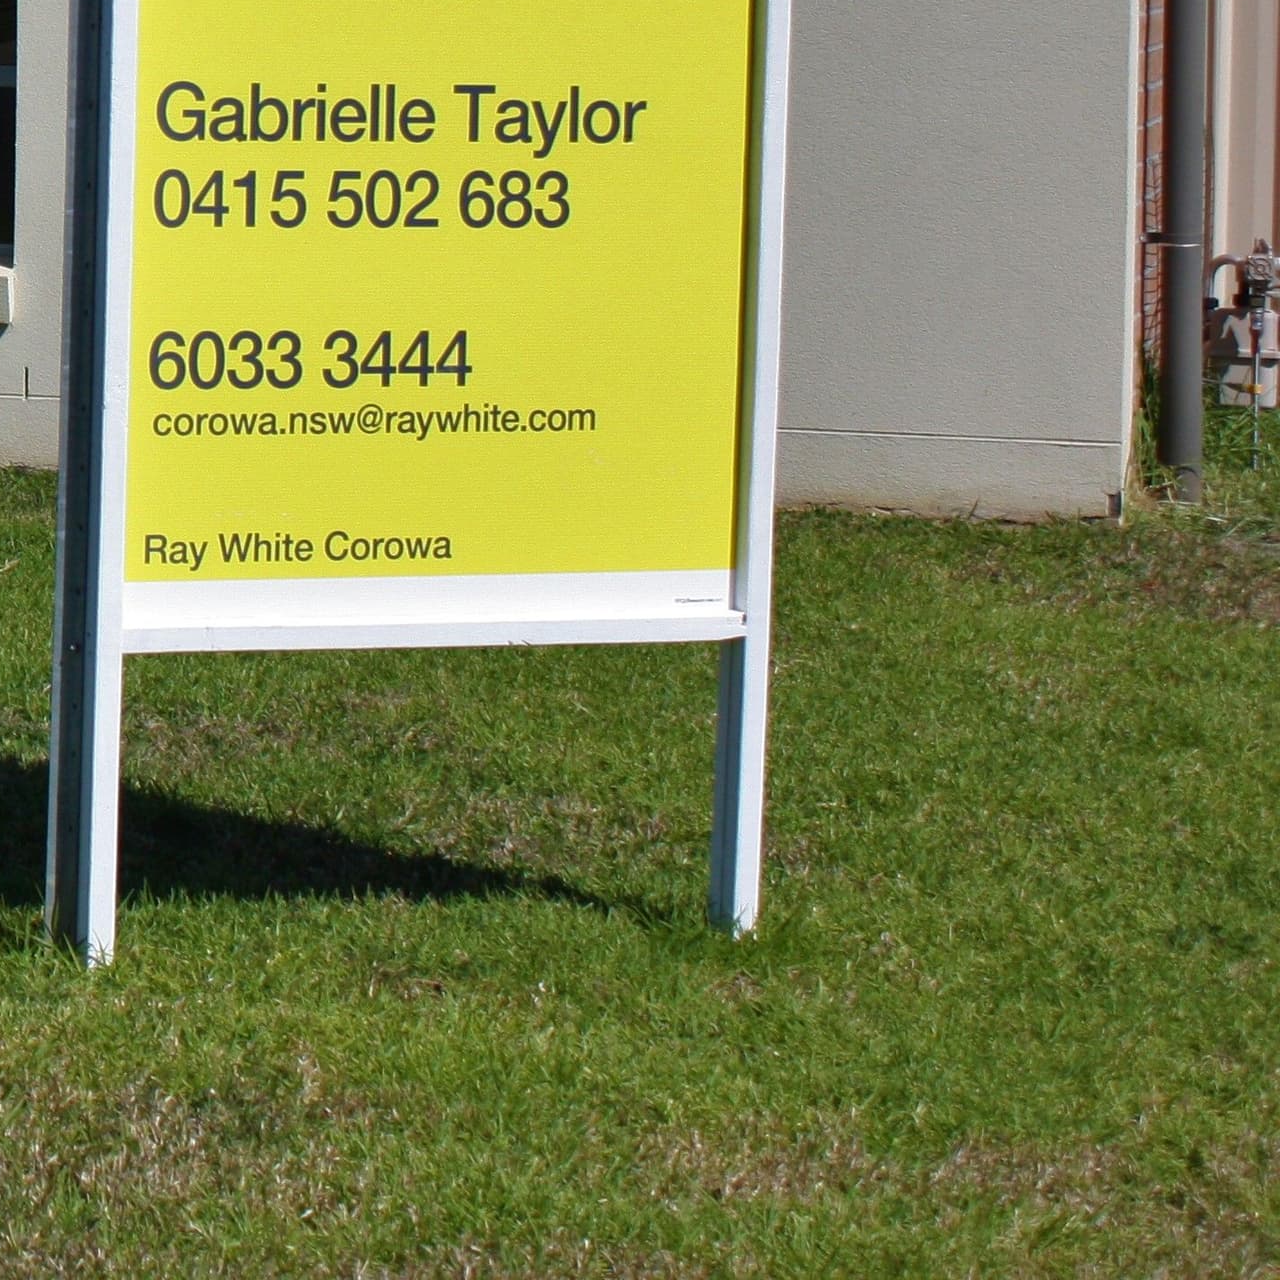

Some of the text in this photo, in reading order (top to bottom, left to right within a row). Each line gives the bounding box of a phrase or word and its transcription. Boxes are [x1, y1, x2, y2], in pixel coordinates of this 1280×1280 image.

[156, 80, 647, 158] Gabrielle Taylor
[154, 169, 570, 229] 0415 502 683
[149, 329, 473, 391] 6033 3444
[152, 403, 597, 441] corowa.nsw@raywhite.com
[144, 530, 452, 570] Ray White Corowa
